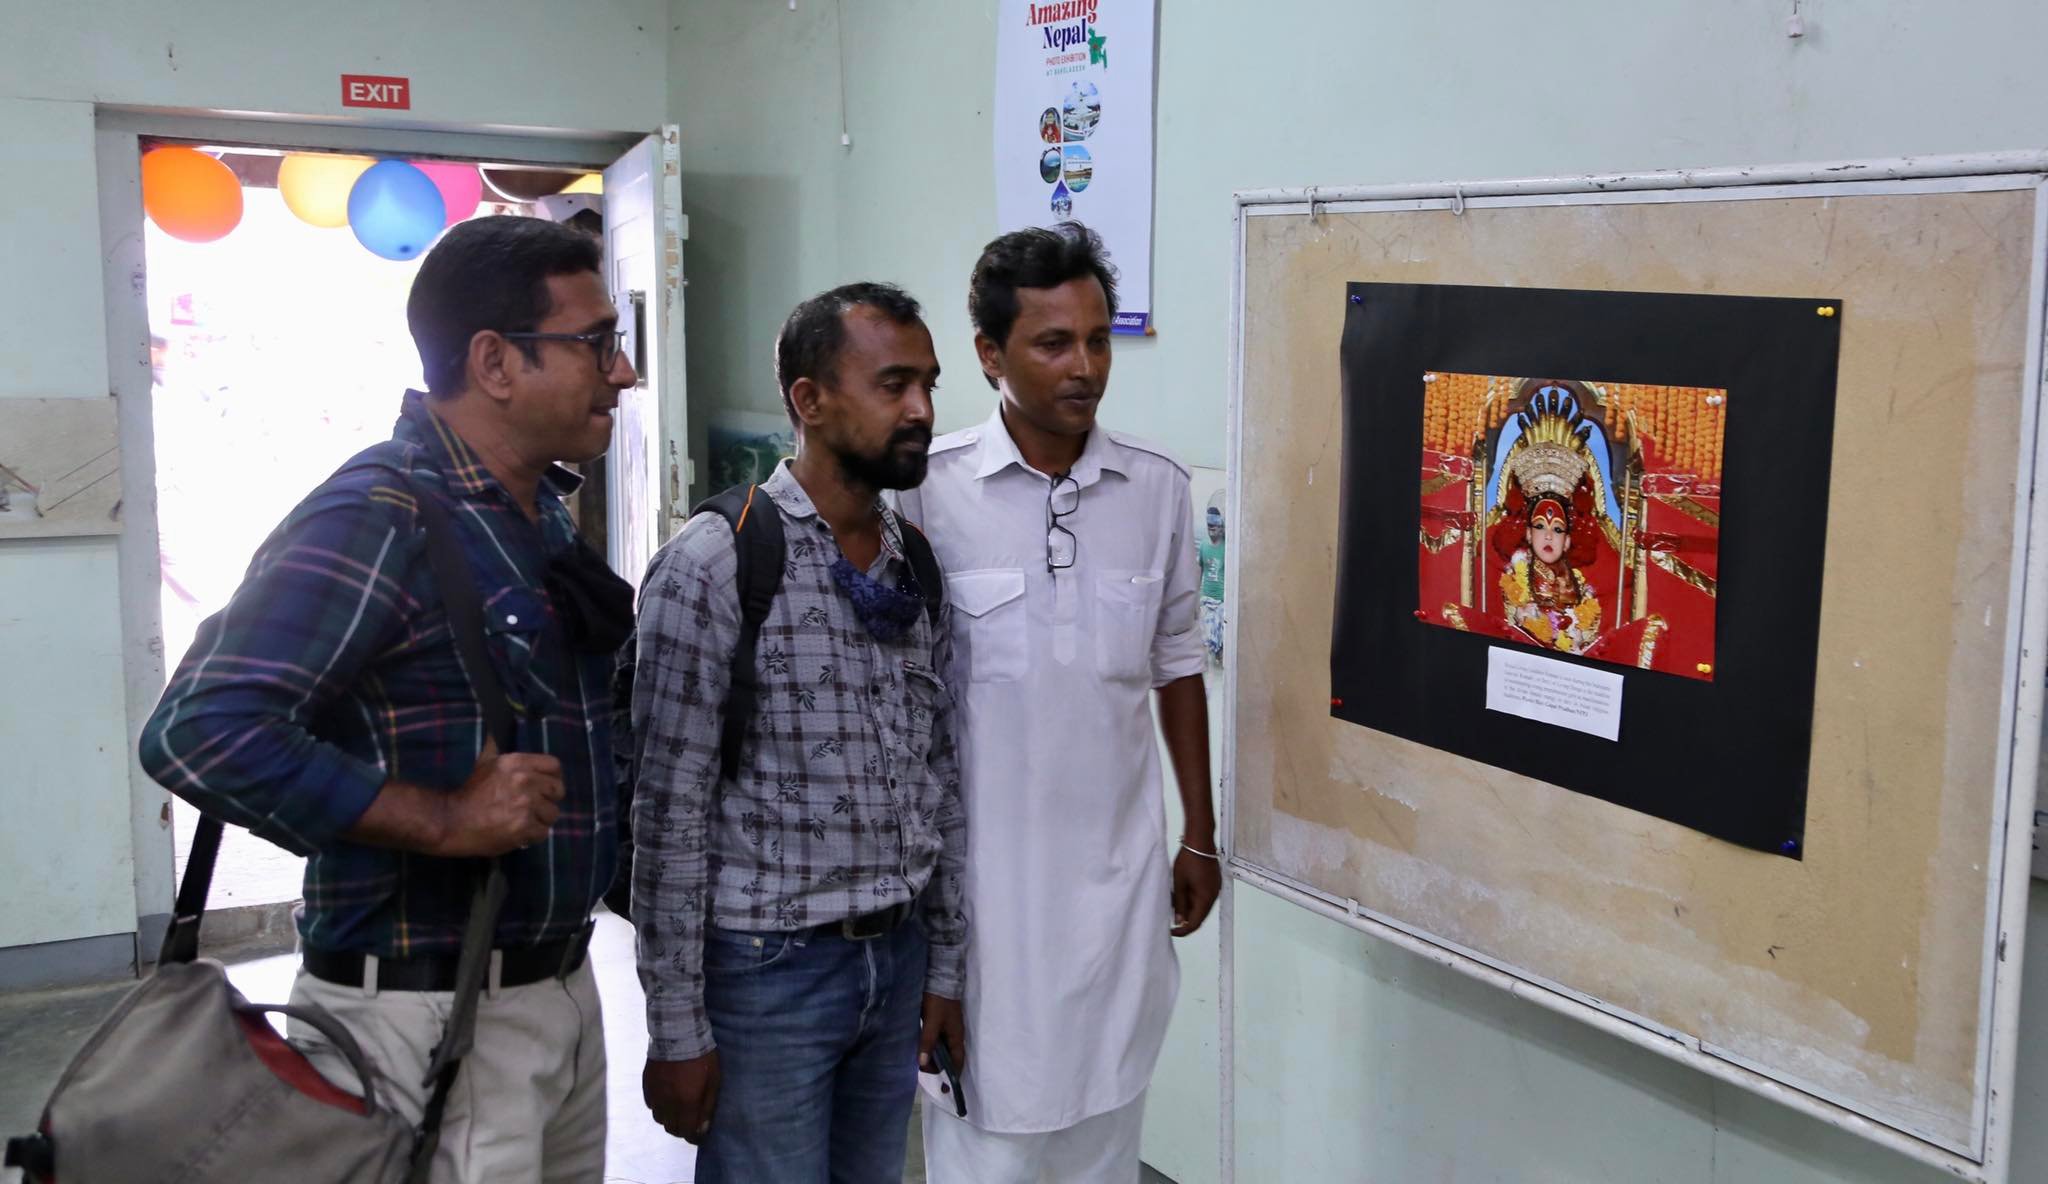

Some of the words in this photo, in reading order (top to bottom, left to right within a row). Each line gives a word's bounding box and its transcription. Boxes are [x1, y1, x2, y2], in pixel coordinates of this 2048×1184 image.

[1026, 0, 1098, 26] Amazing
[1043, 18, 1087, 52] Nepal
[1061, 52, 1087, 64] EXHIBITION
[350, 83, 403, 103] EXIT
